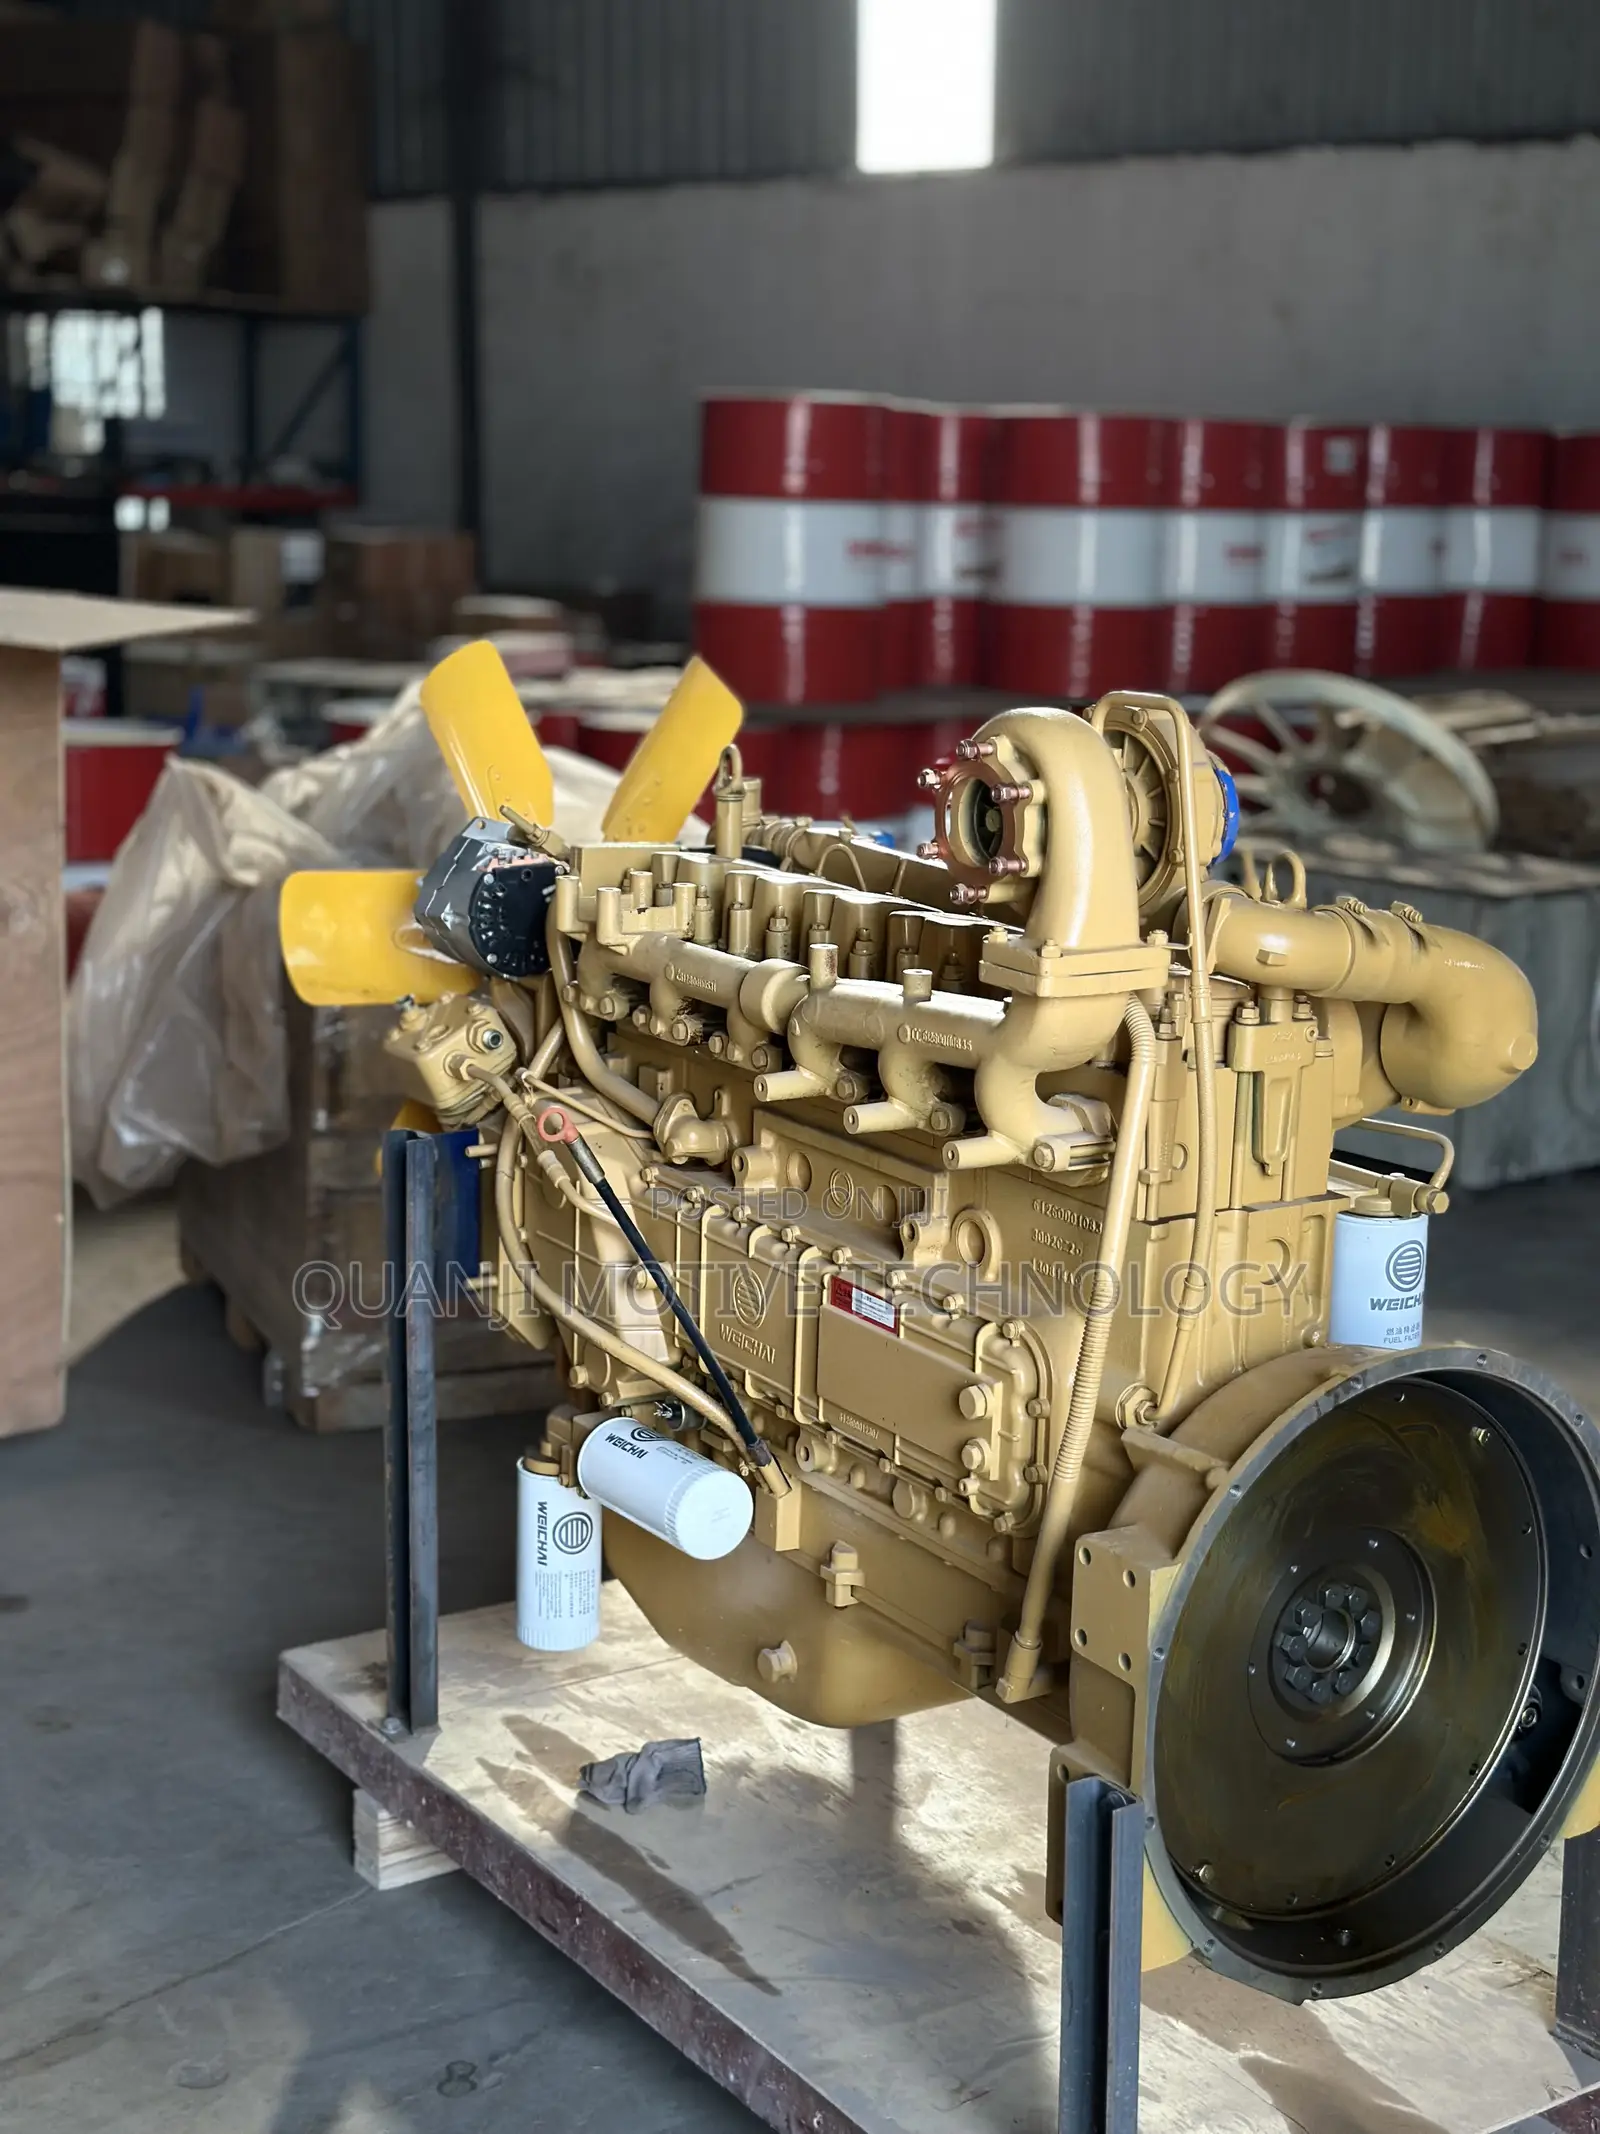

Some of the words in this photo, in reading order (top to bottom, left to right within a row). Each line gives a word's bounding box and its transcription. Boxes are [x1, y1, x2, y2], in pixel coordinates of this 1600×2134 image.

[720, 1323, 775, 1365] WEICHAI
[605, 1433, 649, 1459] WEICHAI
[537, 1501, 548, 1566] WEICHAI
